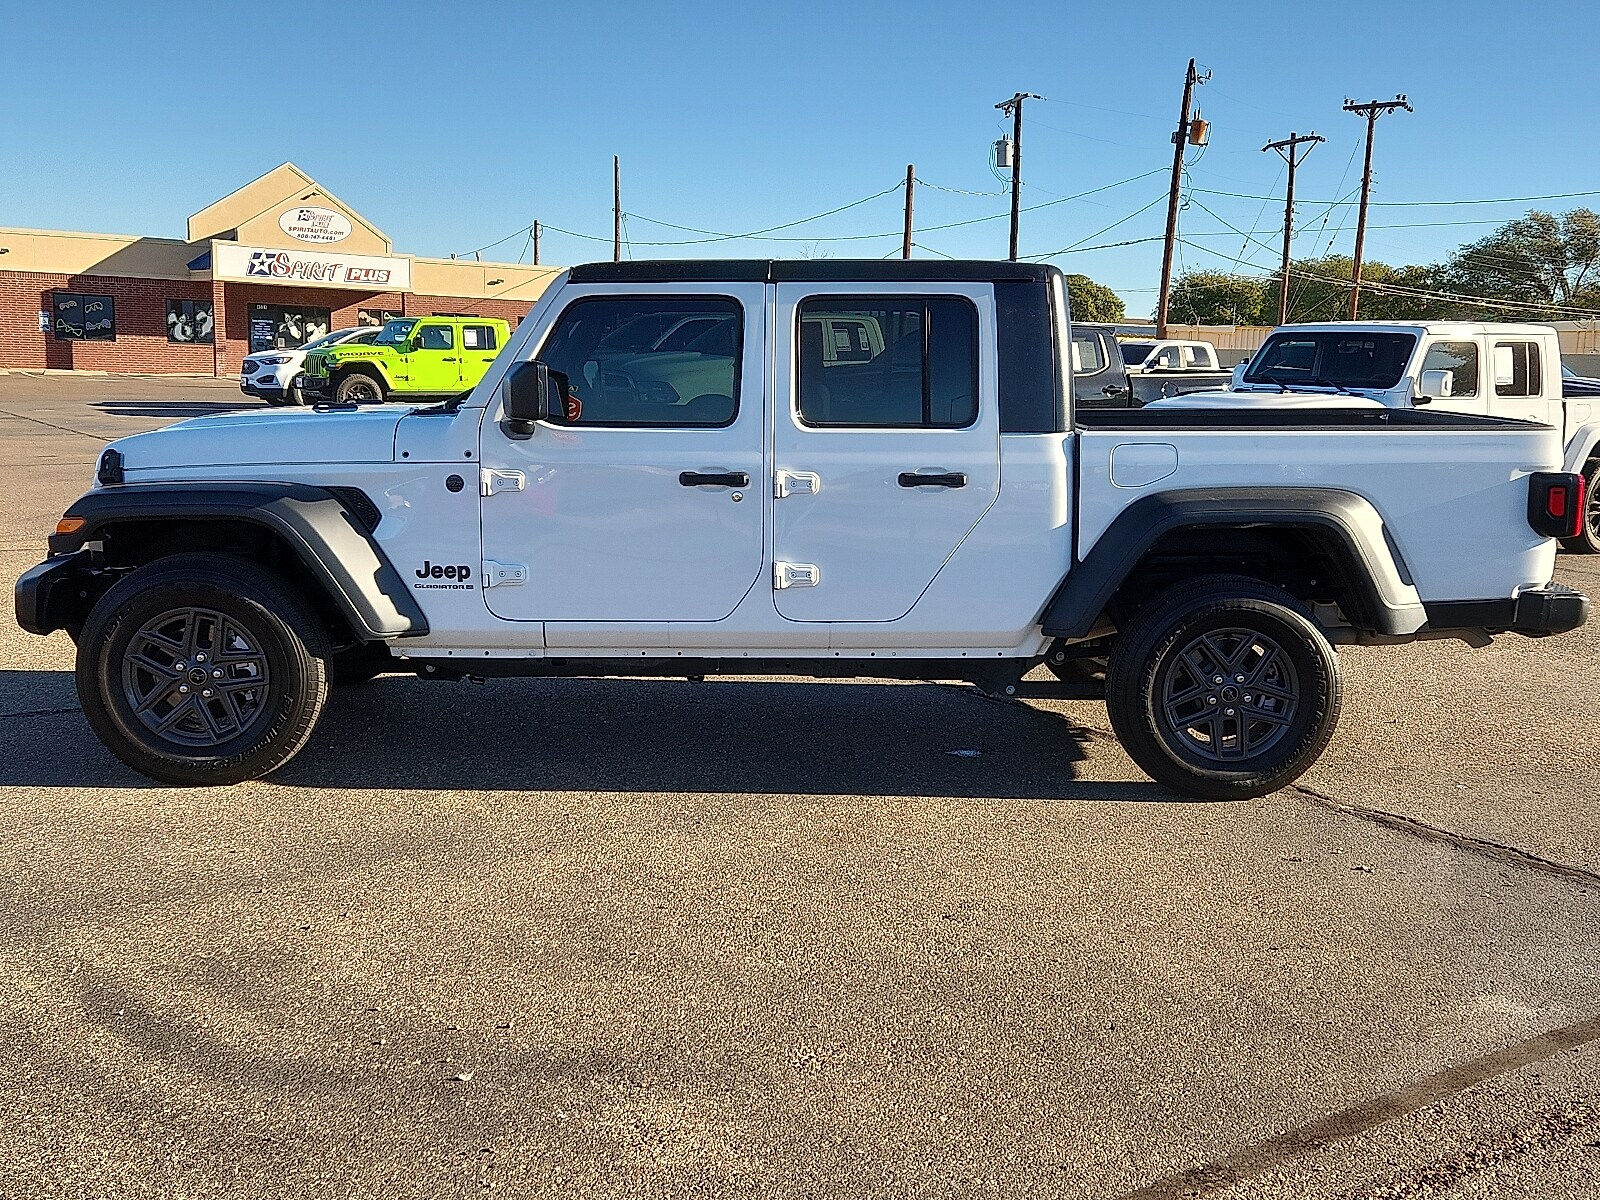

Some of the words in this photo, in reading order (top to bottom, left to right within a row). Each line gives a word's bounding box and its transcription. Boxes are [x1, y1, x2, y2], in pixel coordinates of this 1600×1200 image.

[288, 226, 345, 236] SPIRITAUTO.com
[272, 252, 343, 281] SPIRIT
[347, 268, 391, 283] PLUS
[415, 560, 471, 583] Jeep
